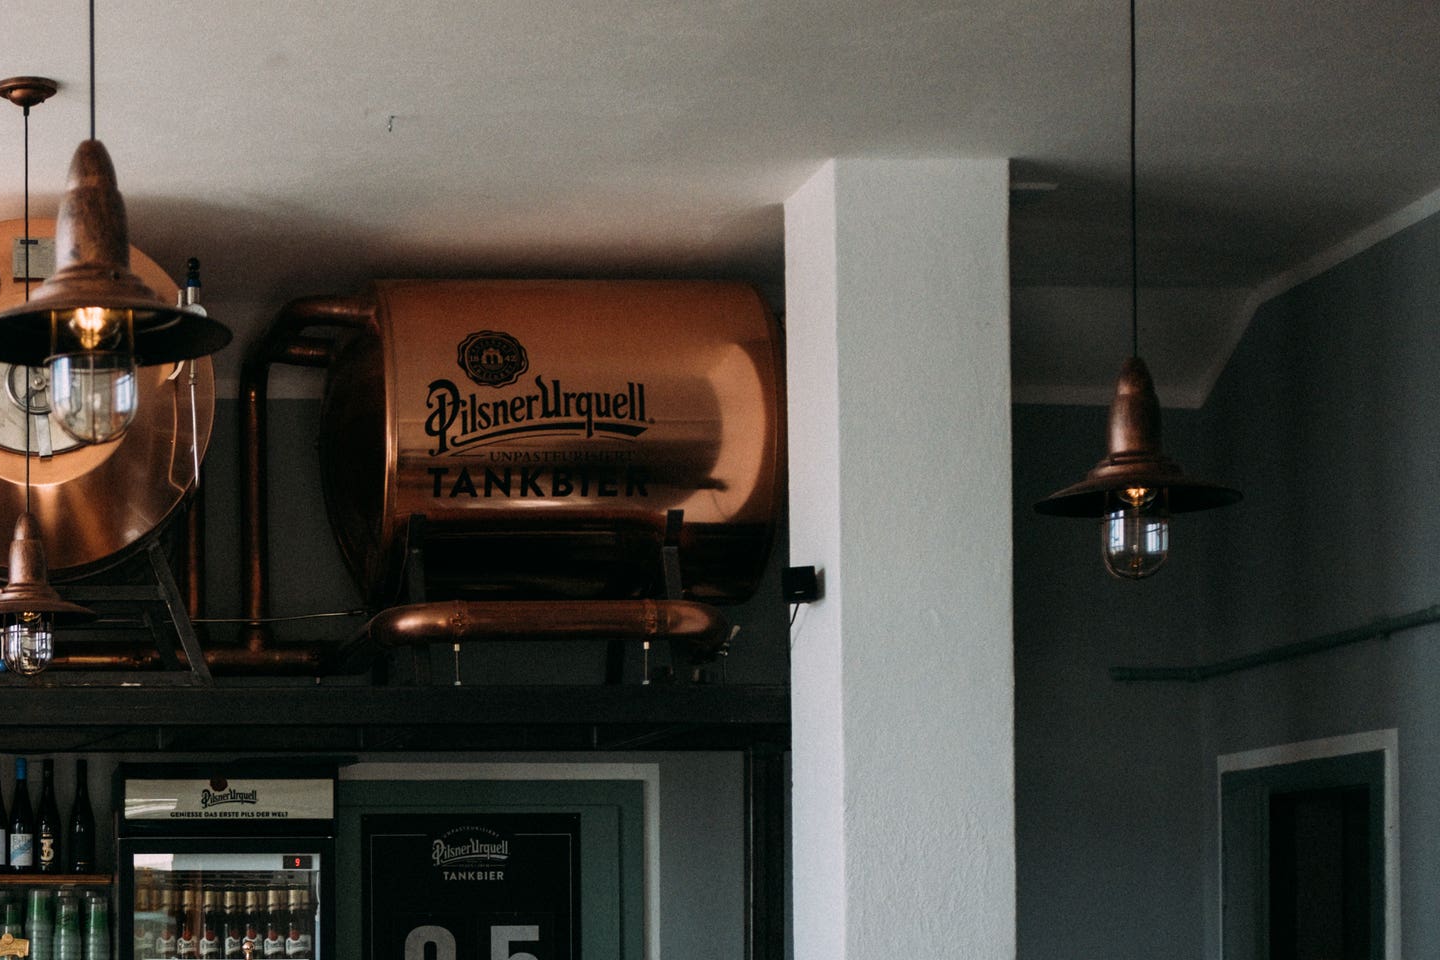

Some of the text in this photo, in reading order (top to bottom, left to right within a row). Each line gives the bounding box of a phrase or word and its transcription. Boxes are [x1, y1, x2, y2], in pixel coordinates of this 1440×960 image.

[424, 374, 645, 457] Pilsner Urquell
[427, 467, 649, 498] TANKBIER
[201, 788, 257, 809] Pilsner Urquell
[295, 857, 301, 867] 9
[432, 838, 508, 867] Pilsner Urquell
[443, 871, 504, 881] TANKBIER
